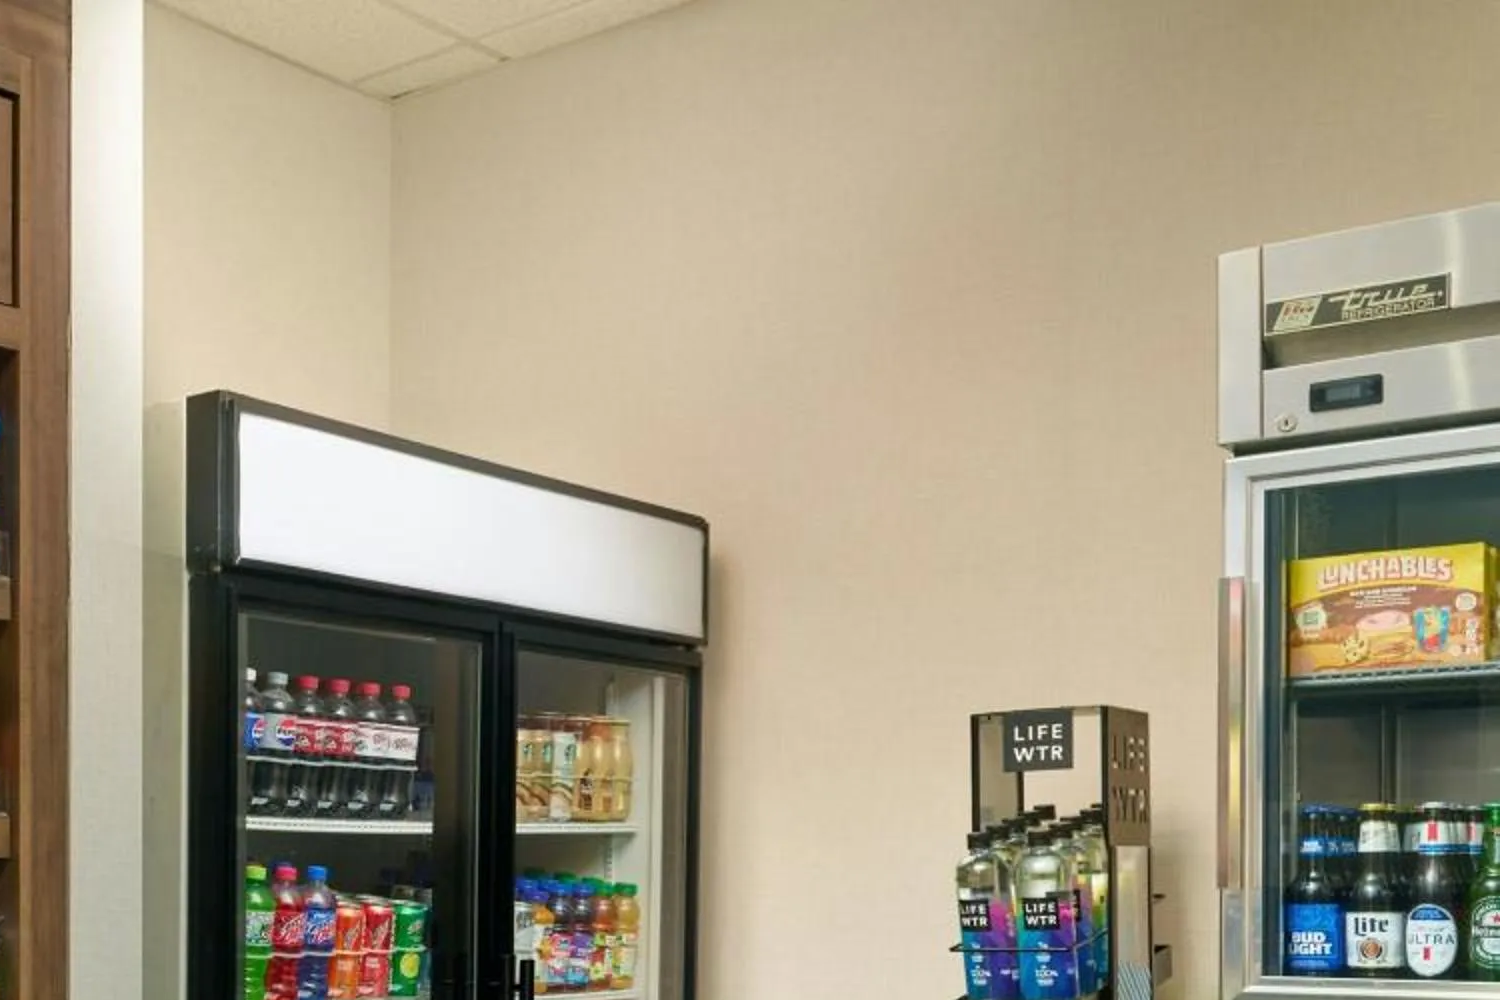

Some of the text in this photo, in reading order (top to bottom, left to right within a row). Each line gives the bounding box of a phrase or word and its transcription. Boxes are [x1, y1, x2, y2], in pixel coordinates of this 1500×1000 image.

[1318, 555, 1453, 590] LUNCHABLES
[1012, 723, 1064, 742] LIFE
[1012, 745, 1064, 763] WTR
[961, 903, 987, 914] LIFE
[1025, 901, 1056, 914] LIFE
[962, 915, 989, 927] WTR
[1025, 914, 1058, 926] WTR
[1353, 916, 1390, 936] Lite
[1291, 931, 1326, 943] BUD
